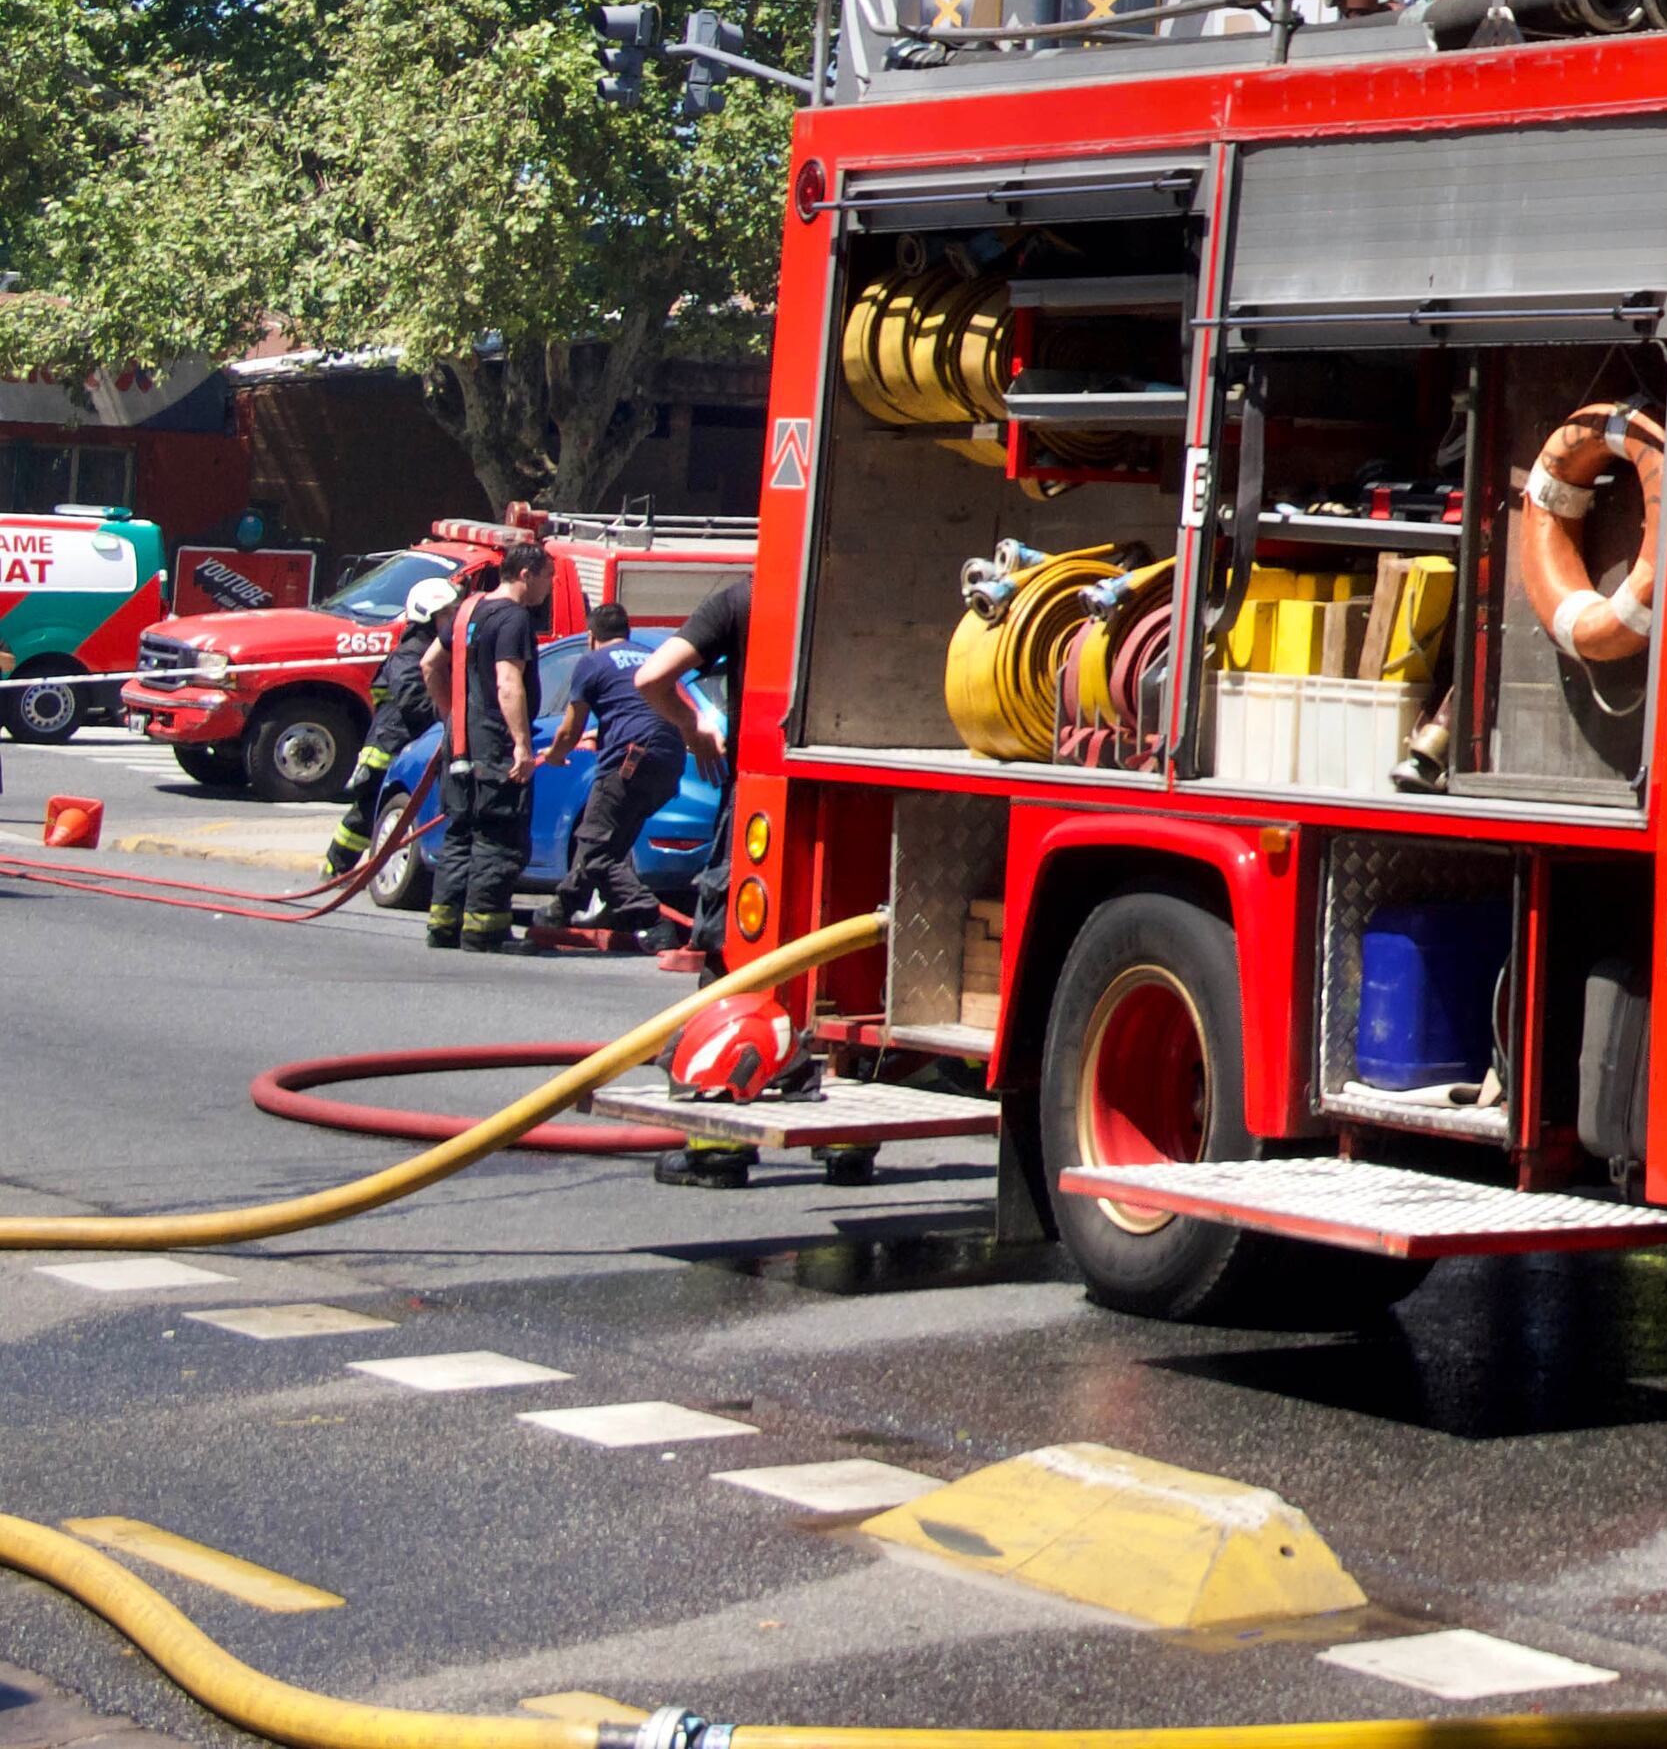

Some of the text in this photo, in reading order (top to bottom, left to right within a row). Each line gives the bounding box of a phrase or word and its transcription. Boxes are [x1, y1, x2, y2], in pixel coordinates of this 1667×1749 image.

[0, 558, 54, 584] AT
[196, 556, 273, 606] YOUTUBE
[336, 632, 393, 653] 2657
